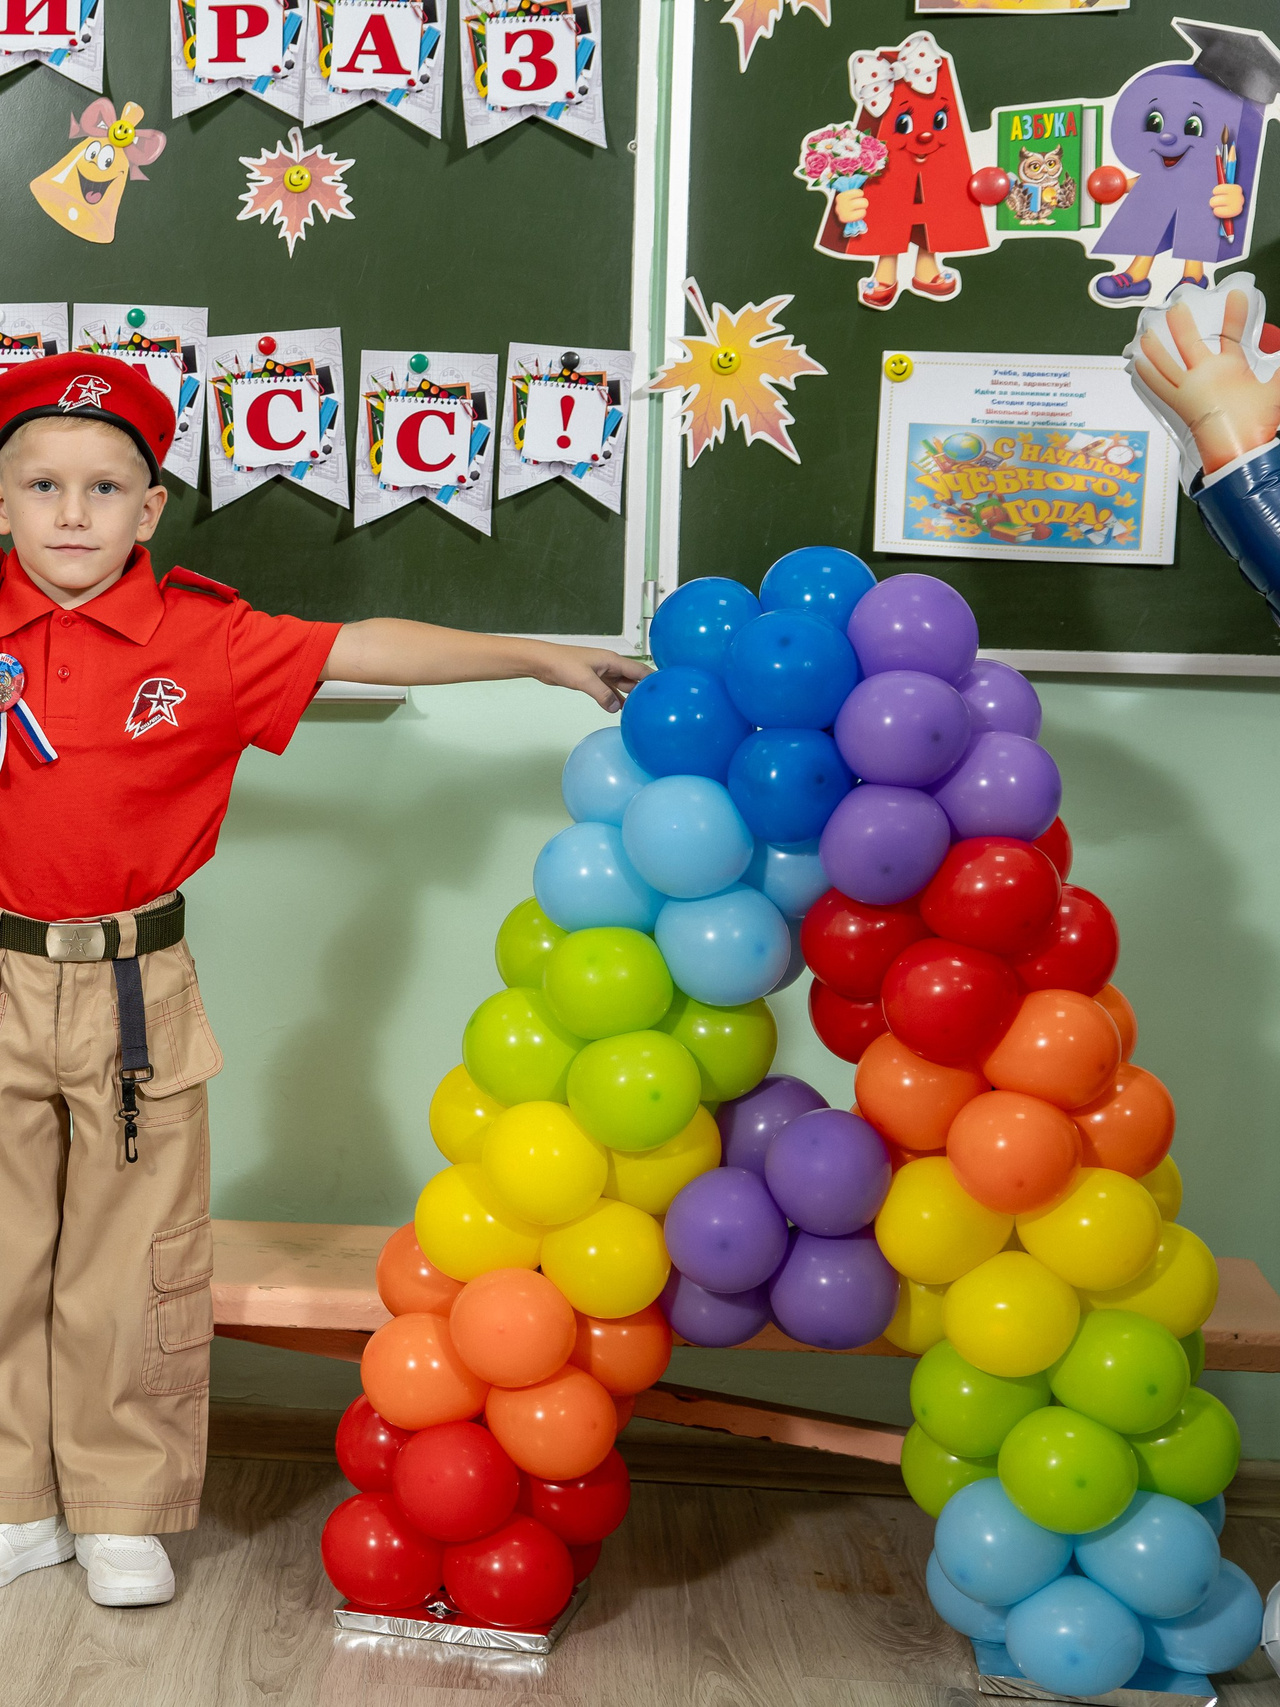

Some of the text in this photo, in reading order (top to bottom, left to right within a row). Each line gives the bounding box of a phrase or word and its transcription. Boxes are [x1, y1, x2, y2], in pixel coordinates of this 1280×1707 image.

[208, 4, 558, 92] РАЗ
[1010, 111, 1078, 142] АЗБУКА
[993, 437, 1143, 484] С НАЧАЛОМ
[916, 466, 1120, 501] УЧЕБНОГО
[1003, 498, 1113, 531] ГОДА!
